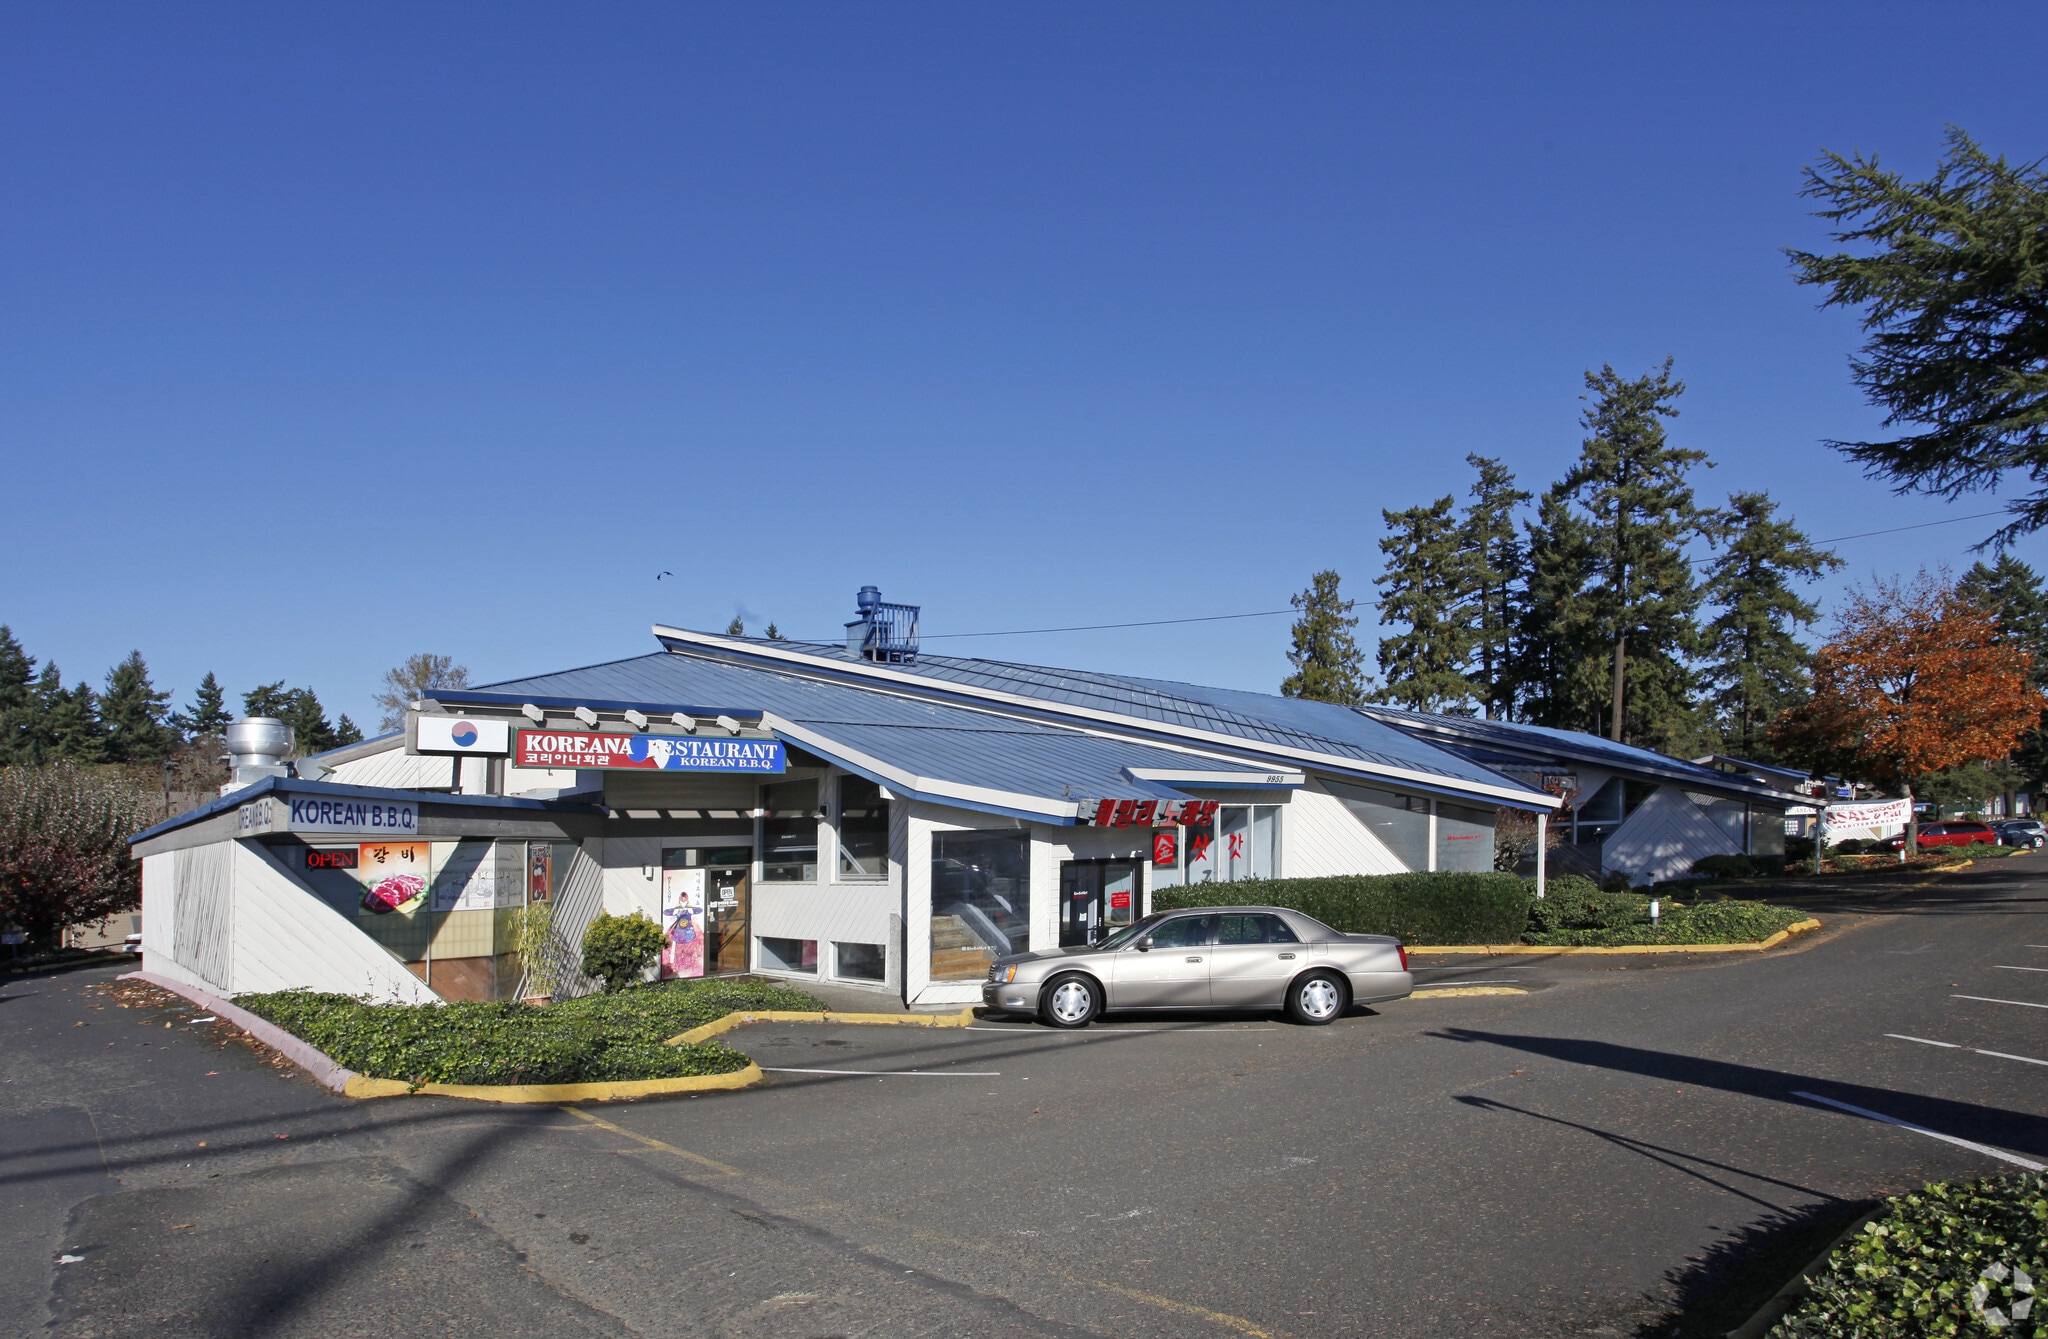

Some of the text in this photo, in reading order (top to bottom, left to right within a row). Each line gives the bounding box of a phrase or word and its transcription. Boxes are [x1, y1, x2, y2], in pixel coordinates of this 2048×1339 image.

[525, 734, 634, 755] KOREANA
[525, 753, 610, 766] 코리아나회관
[680, 757, 773, 770] KOREAN B.B.Q.
[1266, 775, 1284, 783] 9955
[291, 799, 416, 830] KOREAN B.B.Q.
[307, 852, 354, 868] OPEN
